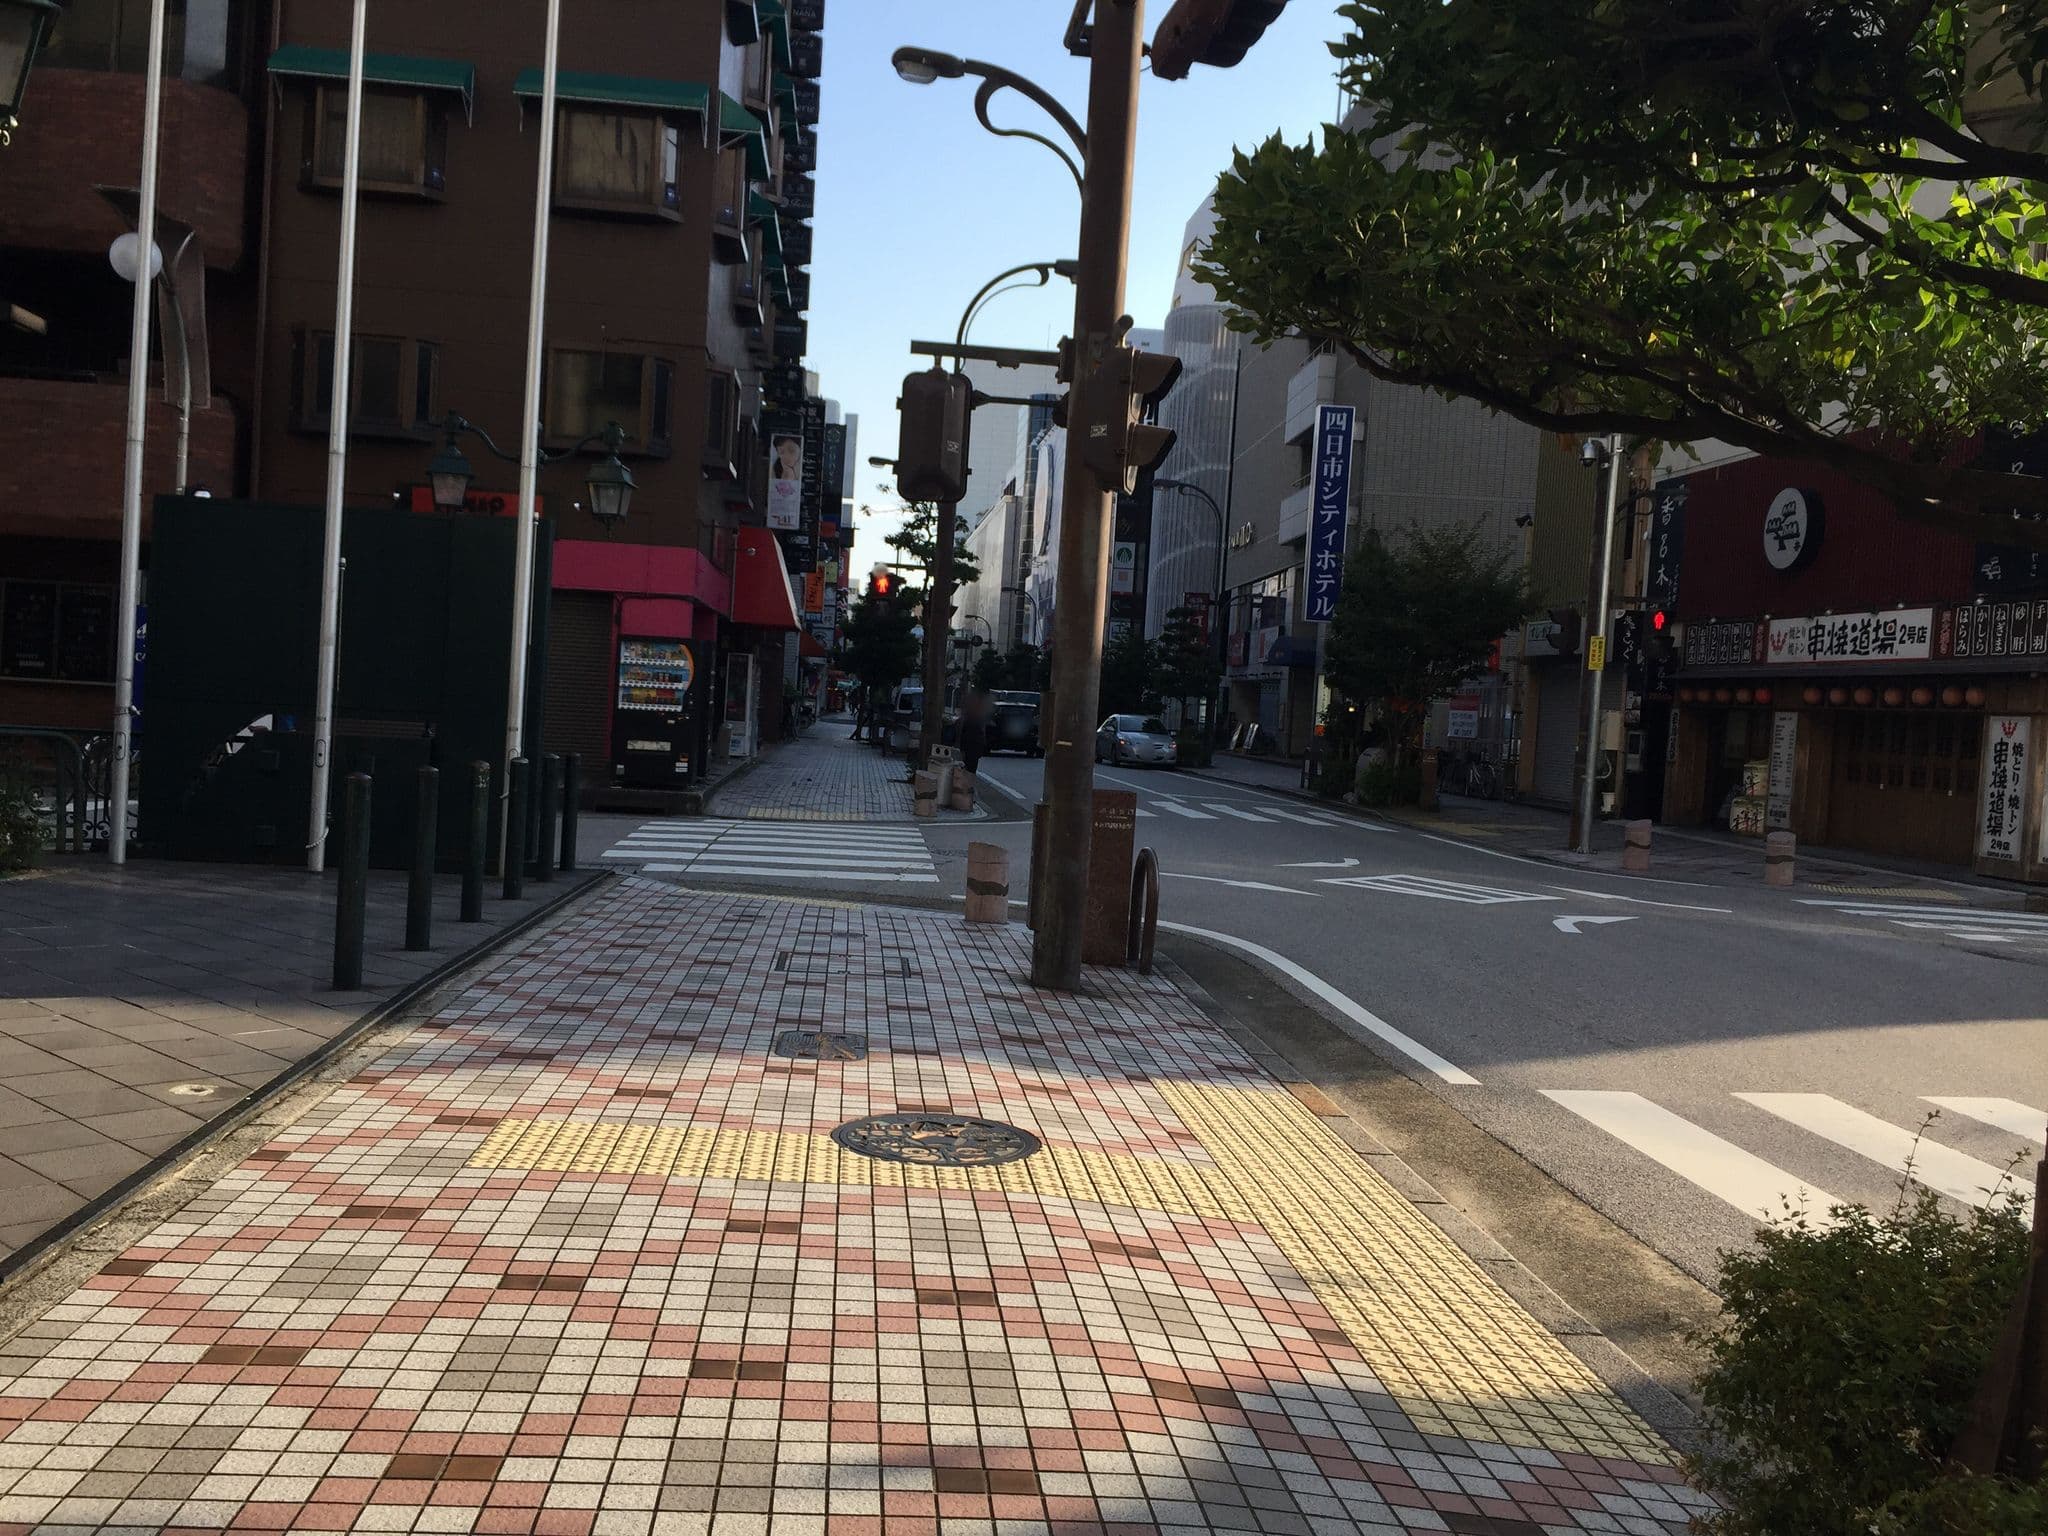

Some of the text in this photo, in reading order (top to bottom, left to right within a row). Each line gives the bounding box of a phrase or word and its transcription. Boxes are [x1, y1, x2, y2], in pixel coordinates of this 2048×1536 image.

[1312, 411, 1348, 617] 四日市シティホテル
[1808, 618, 1928, 660] 串焼道場 2号店
[1957, 609, 1969, 652] はらみ
[1975, 608, 1988, 652] かしら
[1994, 607, 2007, 652] ねぎま
[1987, 738, 2009, 837] 串焼道場
